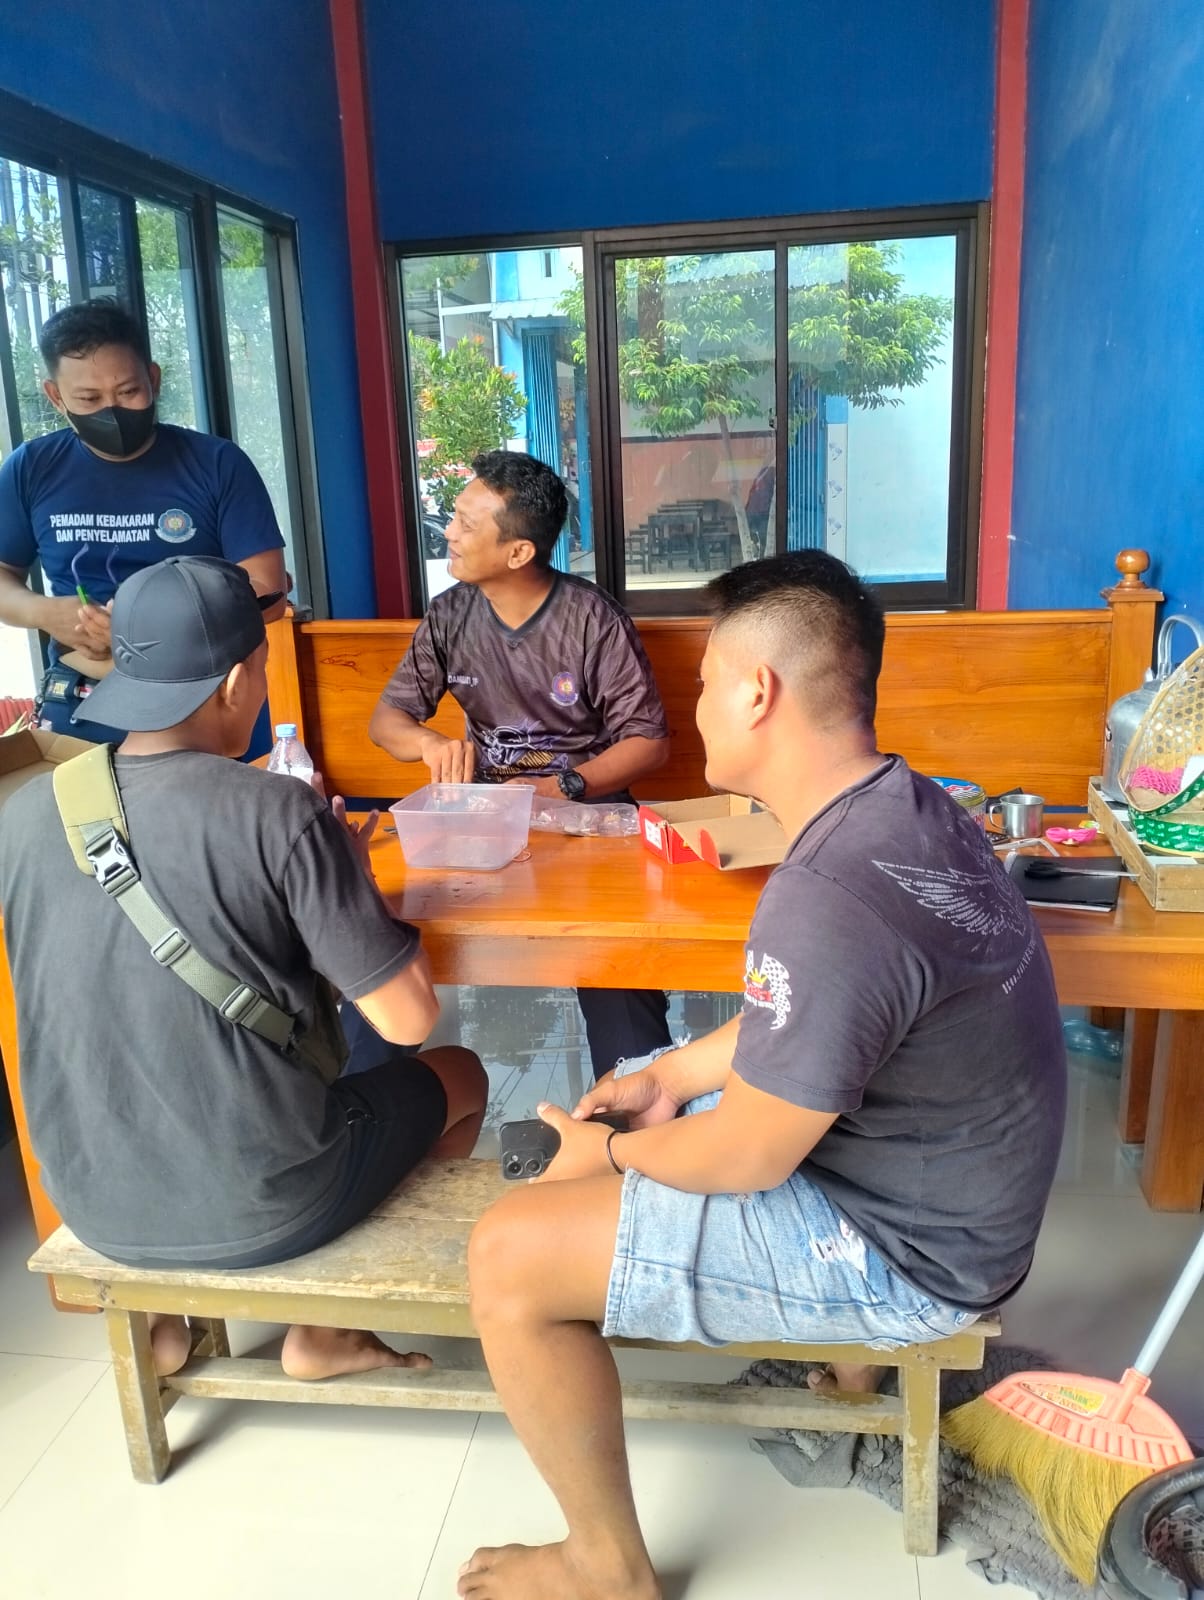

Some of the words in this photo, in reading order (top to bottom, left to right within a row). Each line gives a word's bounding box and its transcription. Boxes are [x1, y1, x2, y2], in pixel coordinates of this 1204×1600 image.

[50, 513, 94, 527] PEMADAM
[96, 513, 155, 527] KEBAKARAN
[56, 529, 73, 542] DAN
[75, 529, 150, 543] PENYELAMATAN
